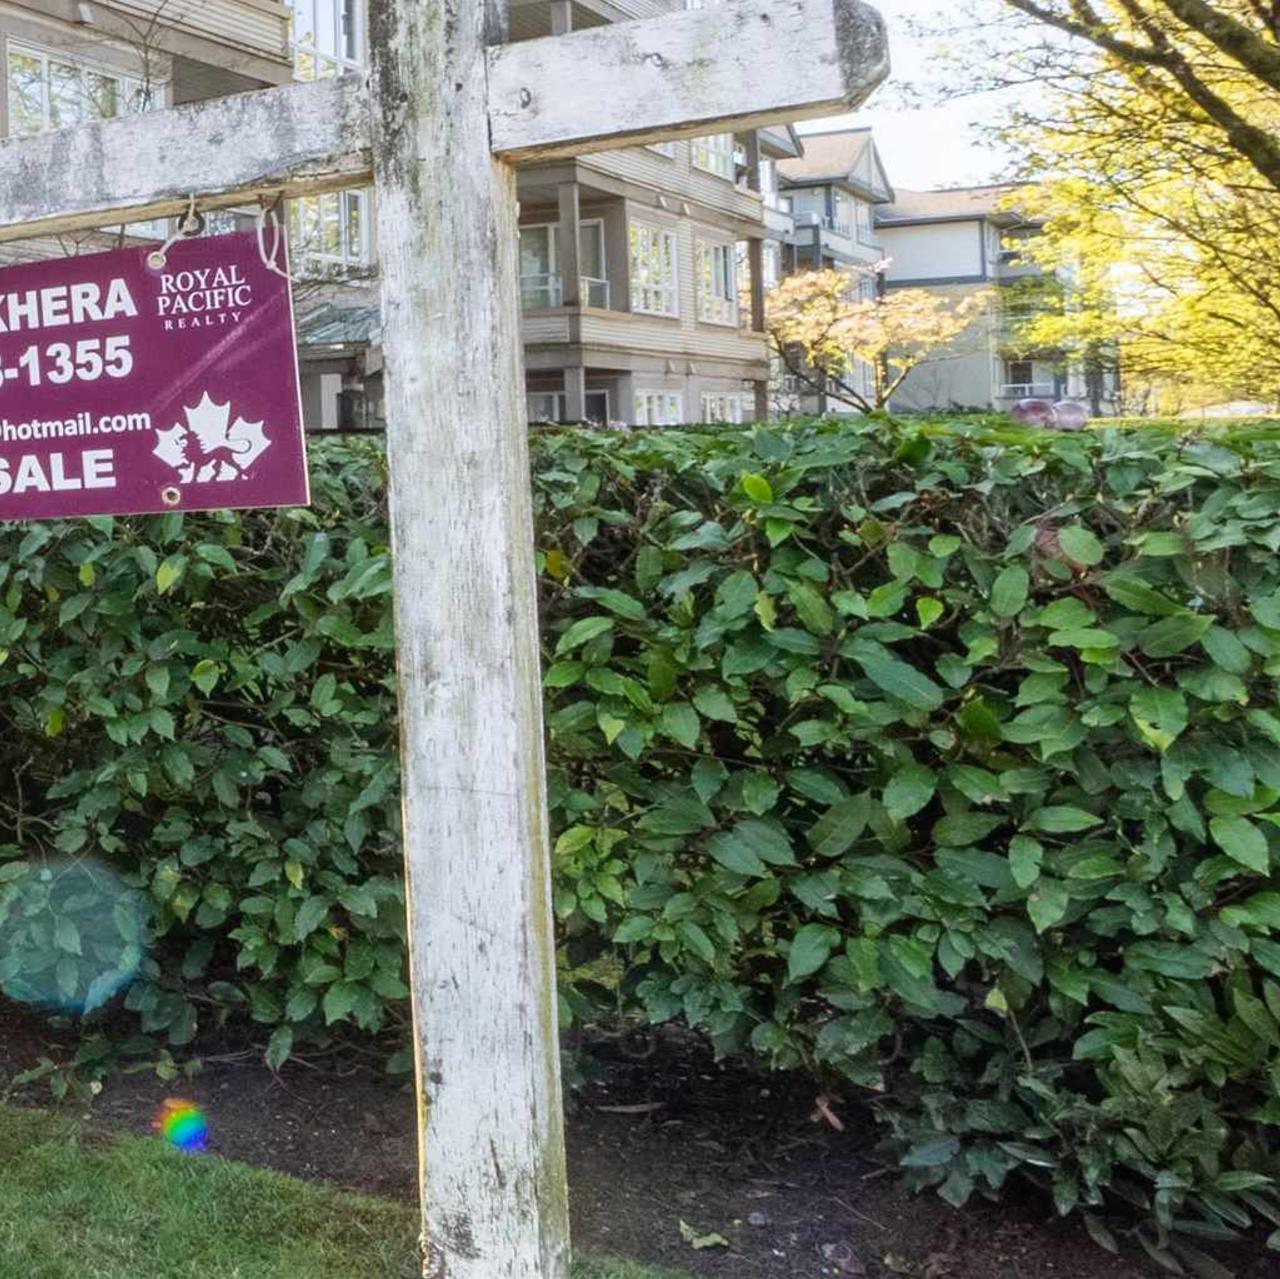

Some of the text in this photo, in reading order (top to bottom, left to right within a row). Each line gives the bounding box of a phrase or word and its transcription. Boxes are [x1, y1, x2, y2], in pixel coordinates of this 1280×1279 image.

[160, 264, 246, 295] ROYAL
[157, 285, 252, 316] PACIFIC
[164, 311, 241, 331] REALTY
